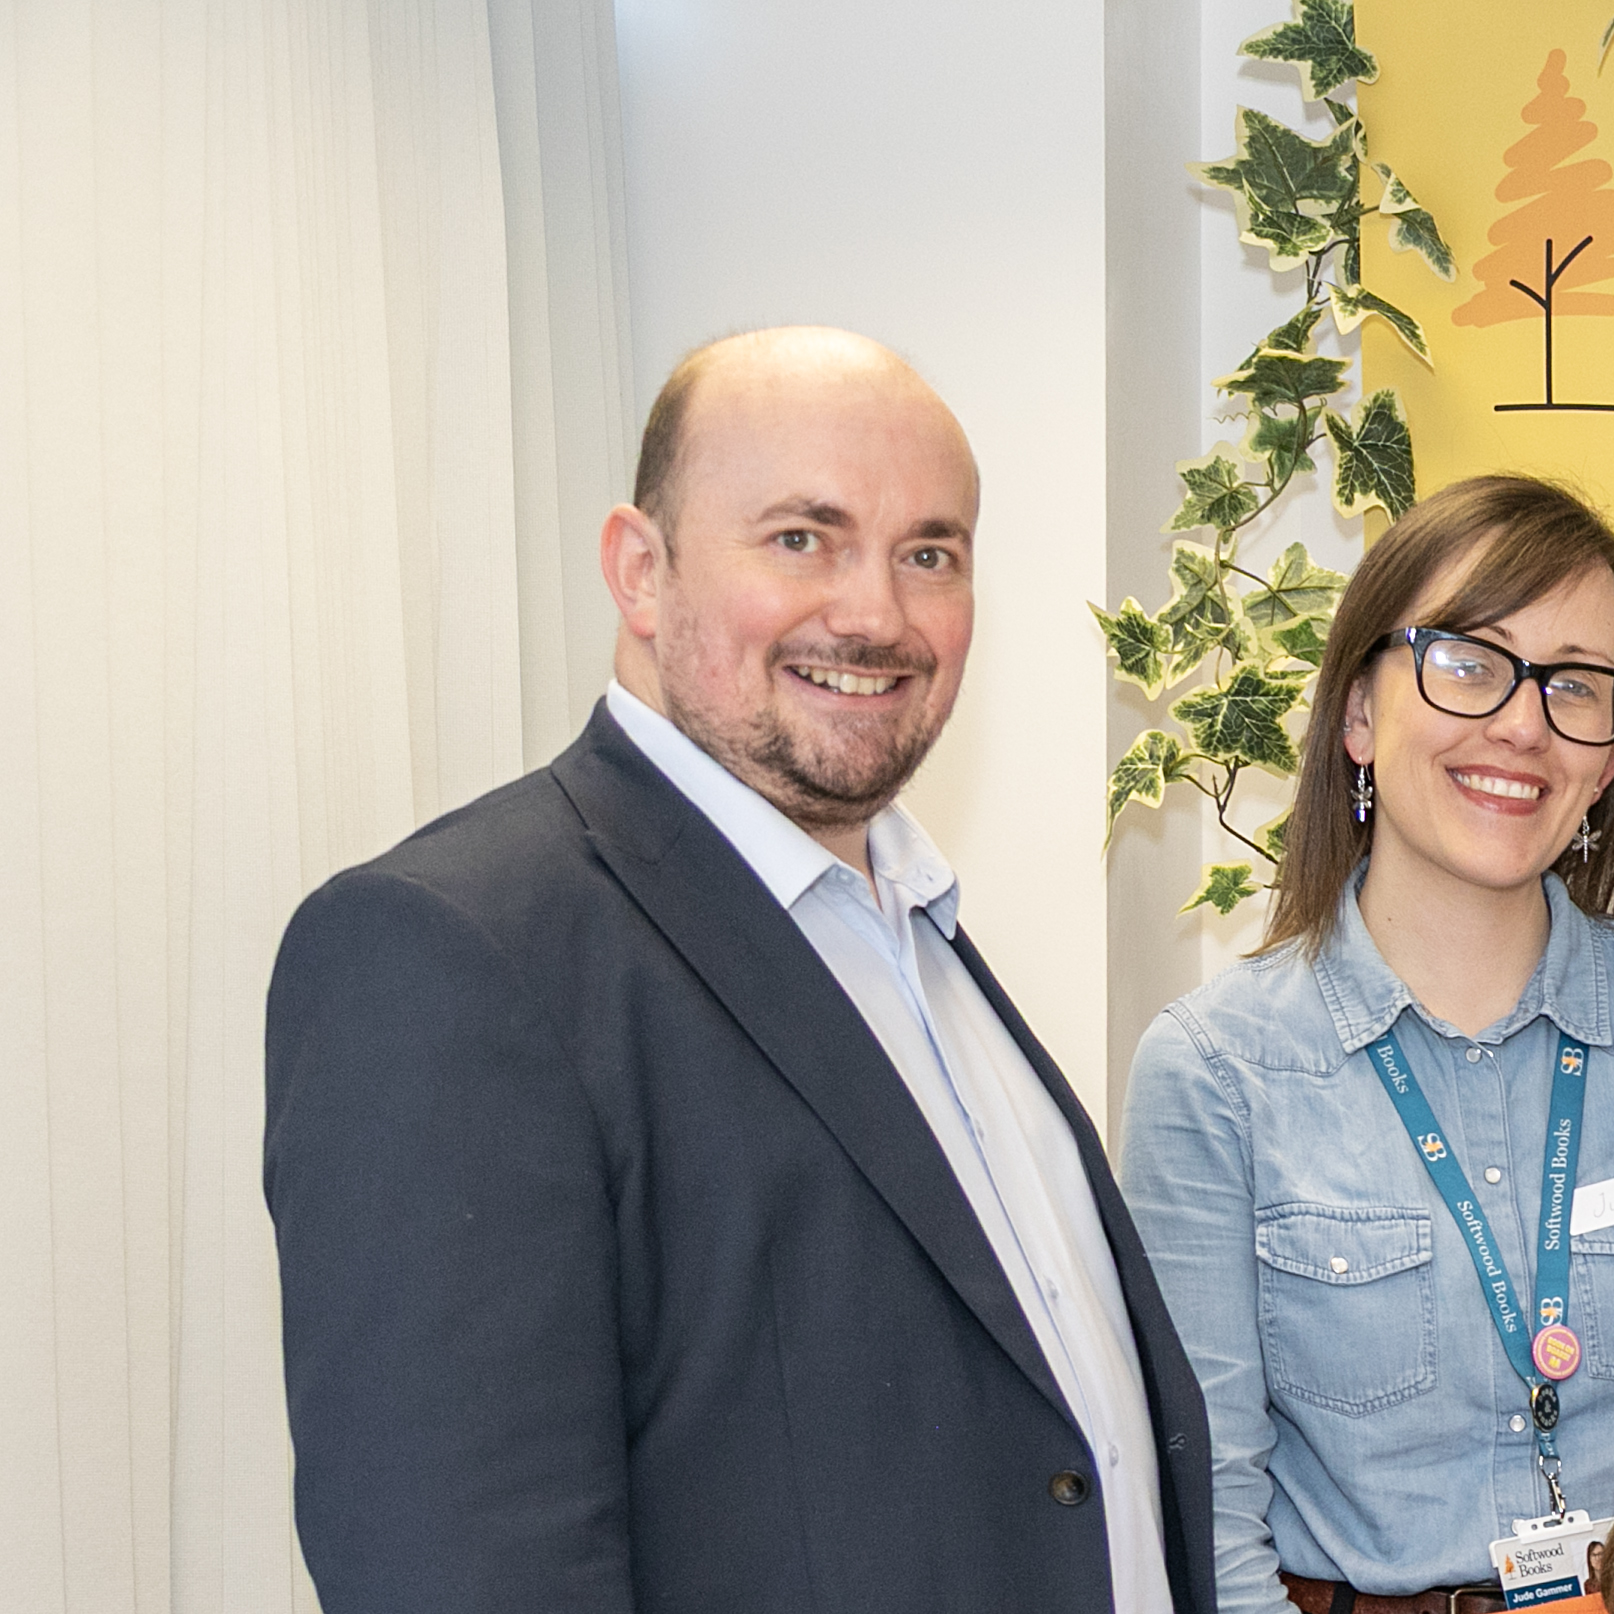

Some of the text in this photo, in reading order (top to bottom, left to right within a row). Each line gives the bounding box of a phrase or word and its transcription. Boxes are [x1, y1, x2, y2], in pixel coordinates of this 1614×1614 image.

[1375, 1045, 1410, 1095] Books
[1544, 1118, 1572, 1251] Softwood Books
[1457, 1200, 1517, 1333] Softwood Books
[1515, 1543, 1564, 1564] Softwood
[1518, 1561, 1553, 1578] Books
[1512, 1583, 1573, 1603] Jude Gammer
